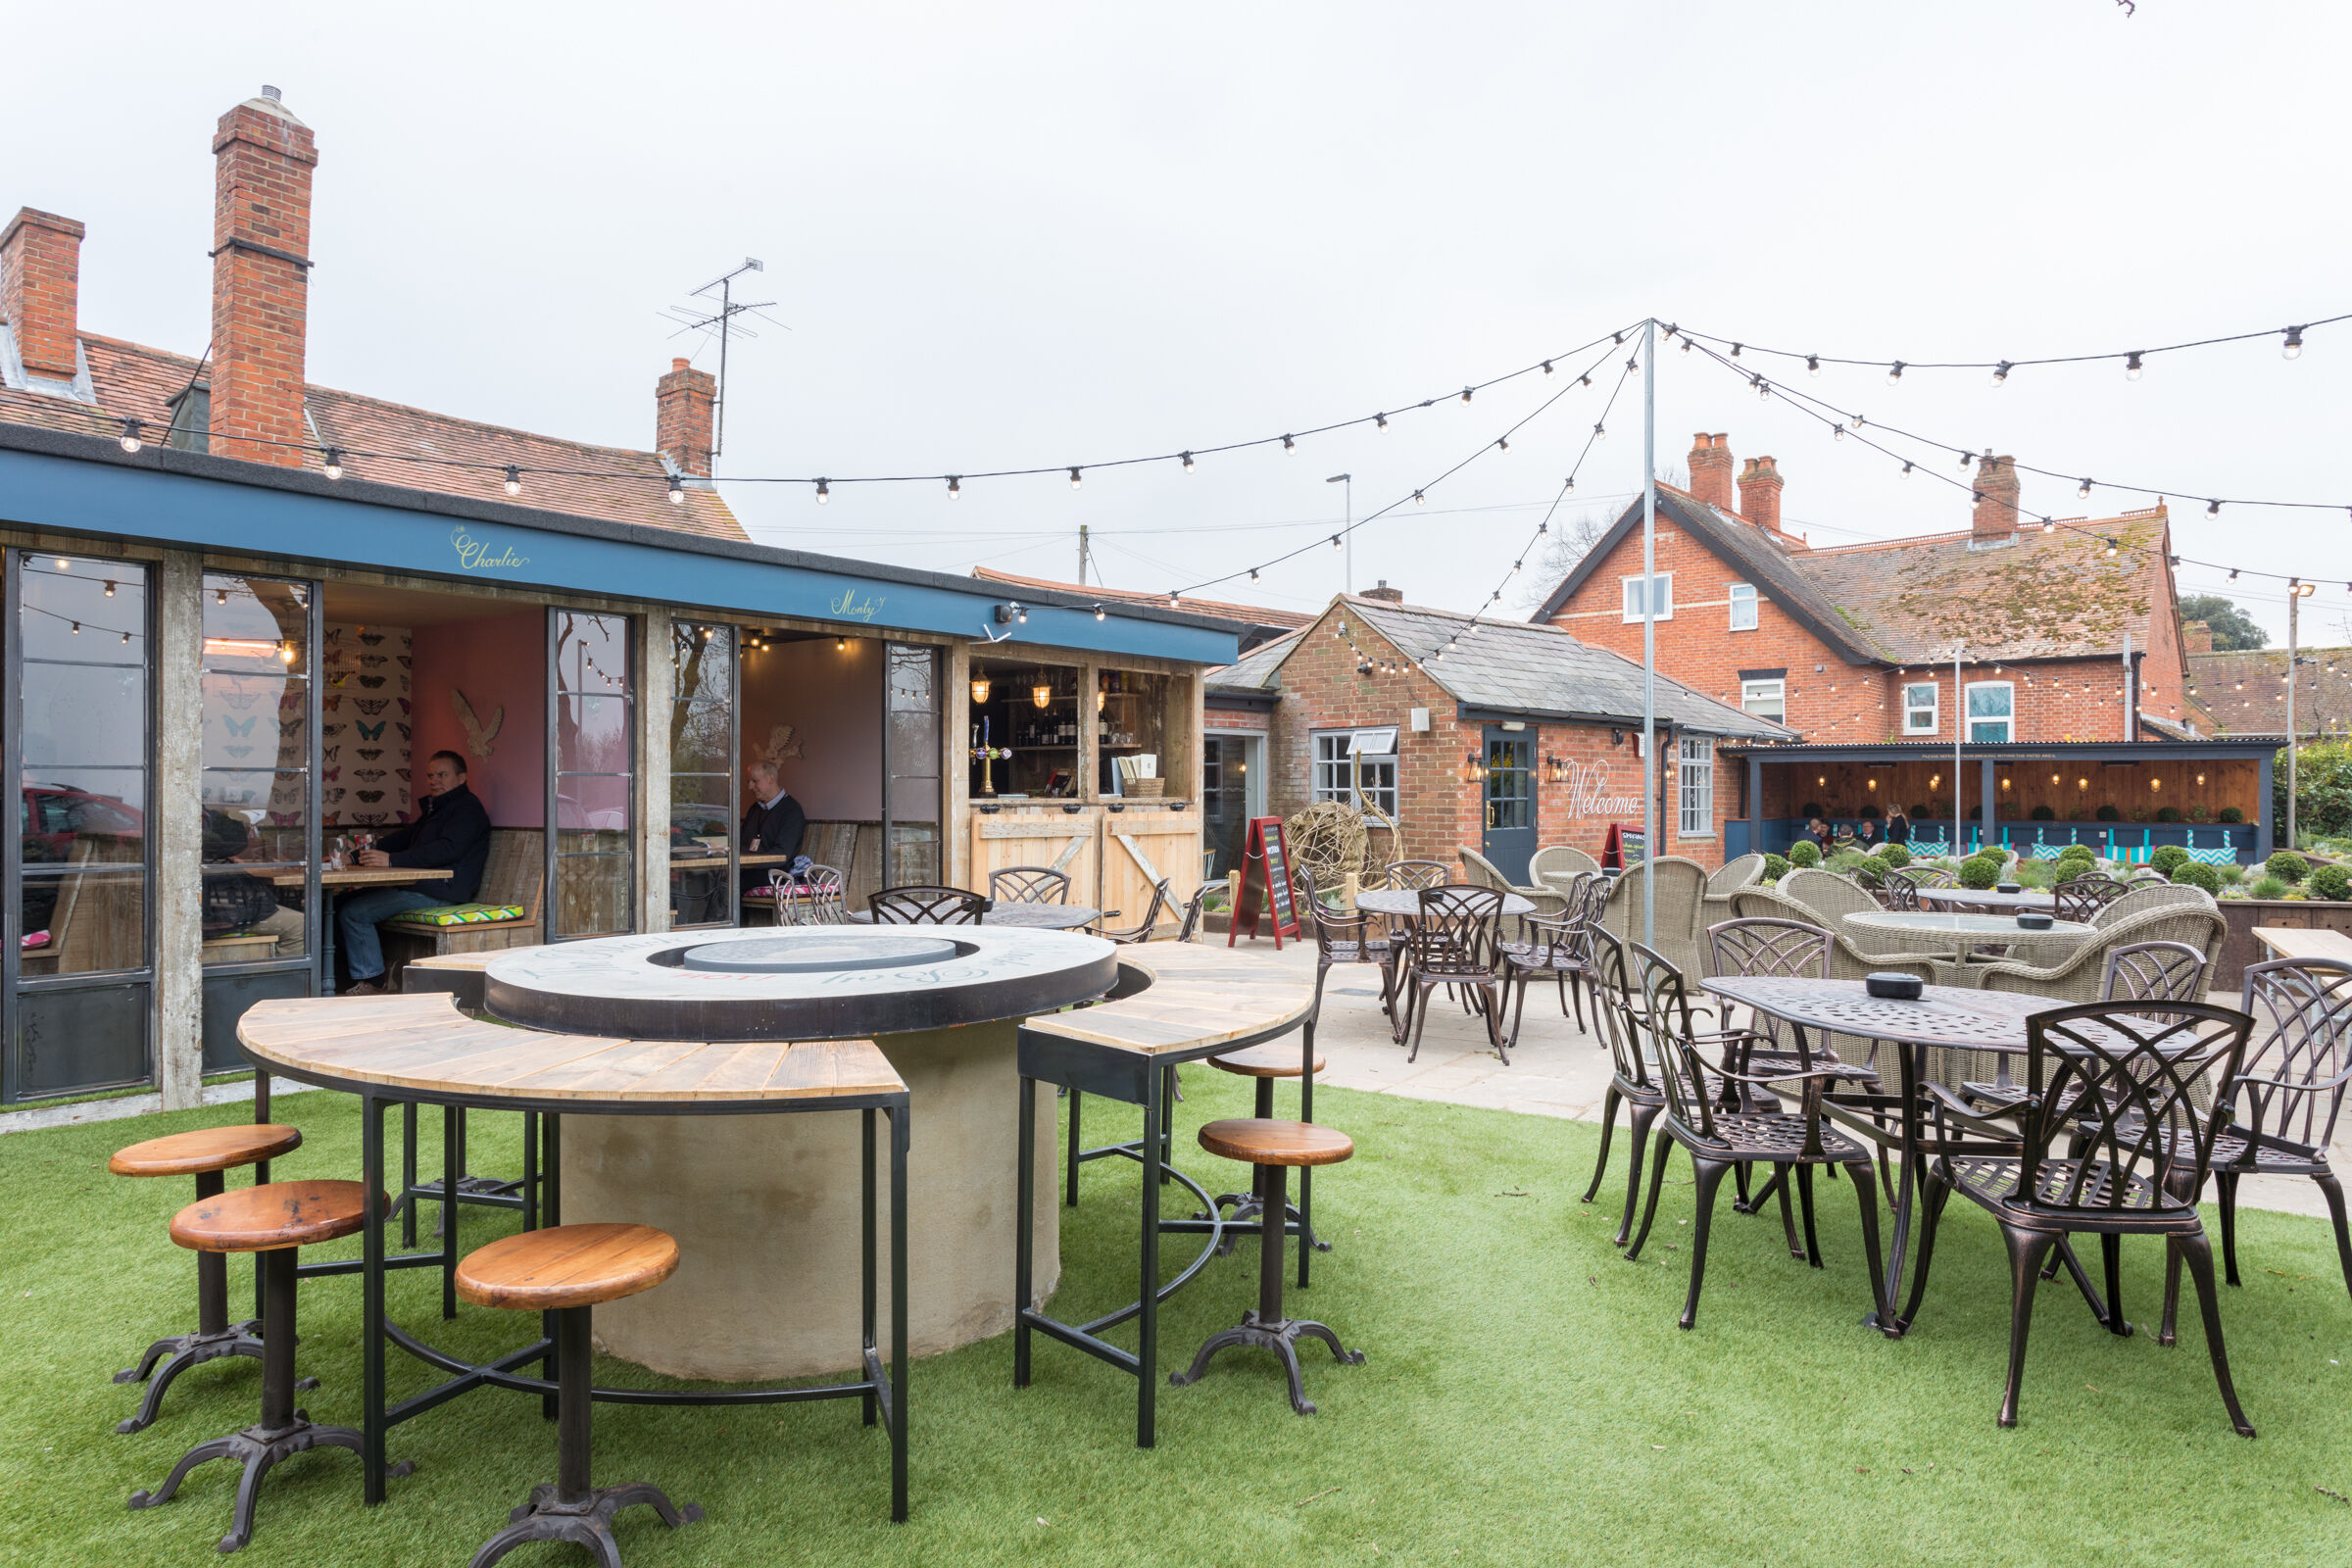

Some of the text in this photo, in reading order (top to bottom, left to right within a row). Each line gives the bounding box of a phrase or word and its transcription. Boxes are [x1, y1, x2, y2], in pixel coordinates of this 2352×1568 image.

[450, 525, 530, 569] Charlie
[830, 588, 886, 622] Monty
[1562, 759, 1641, 820] Welcome
